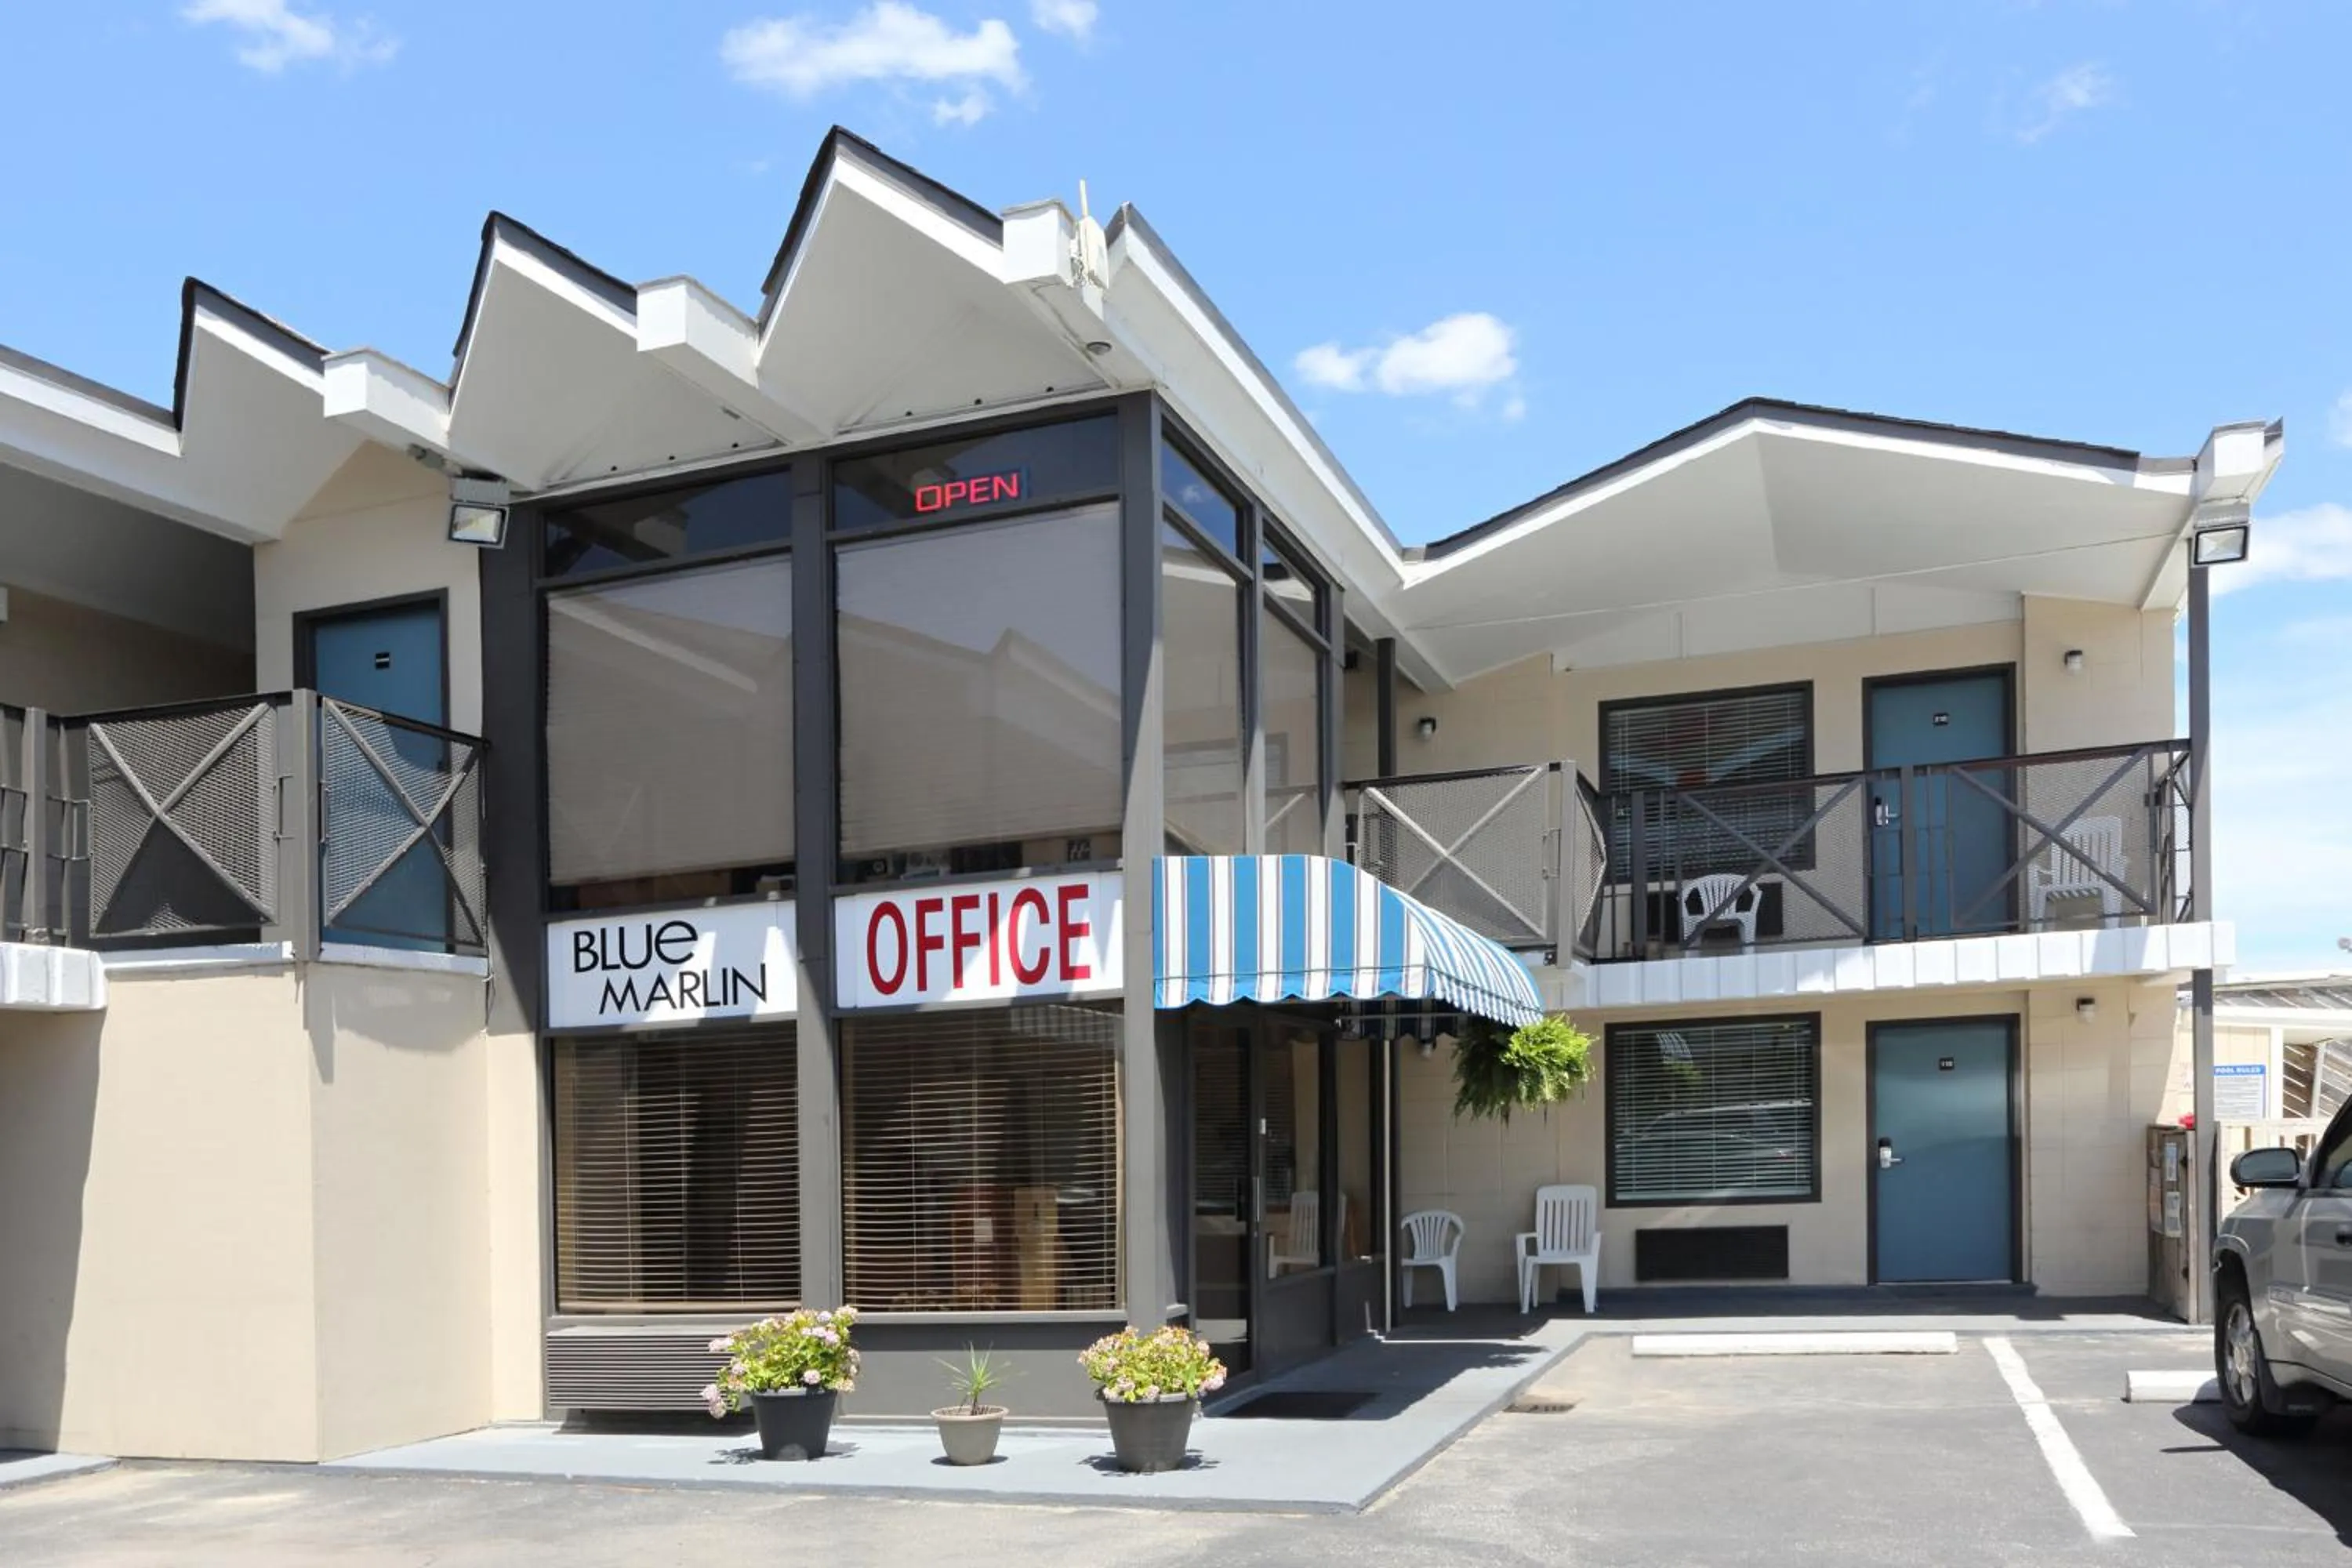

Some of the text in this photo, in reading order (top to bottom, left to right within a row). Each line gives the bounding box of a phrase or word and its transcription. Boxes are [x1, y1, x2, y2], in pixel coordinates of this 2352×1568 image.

[915, 474, 1019, 512] OPEN
[866, 884, 1092, 995] OFFICE
[598, 964, 766, 1014] MARLIN
